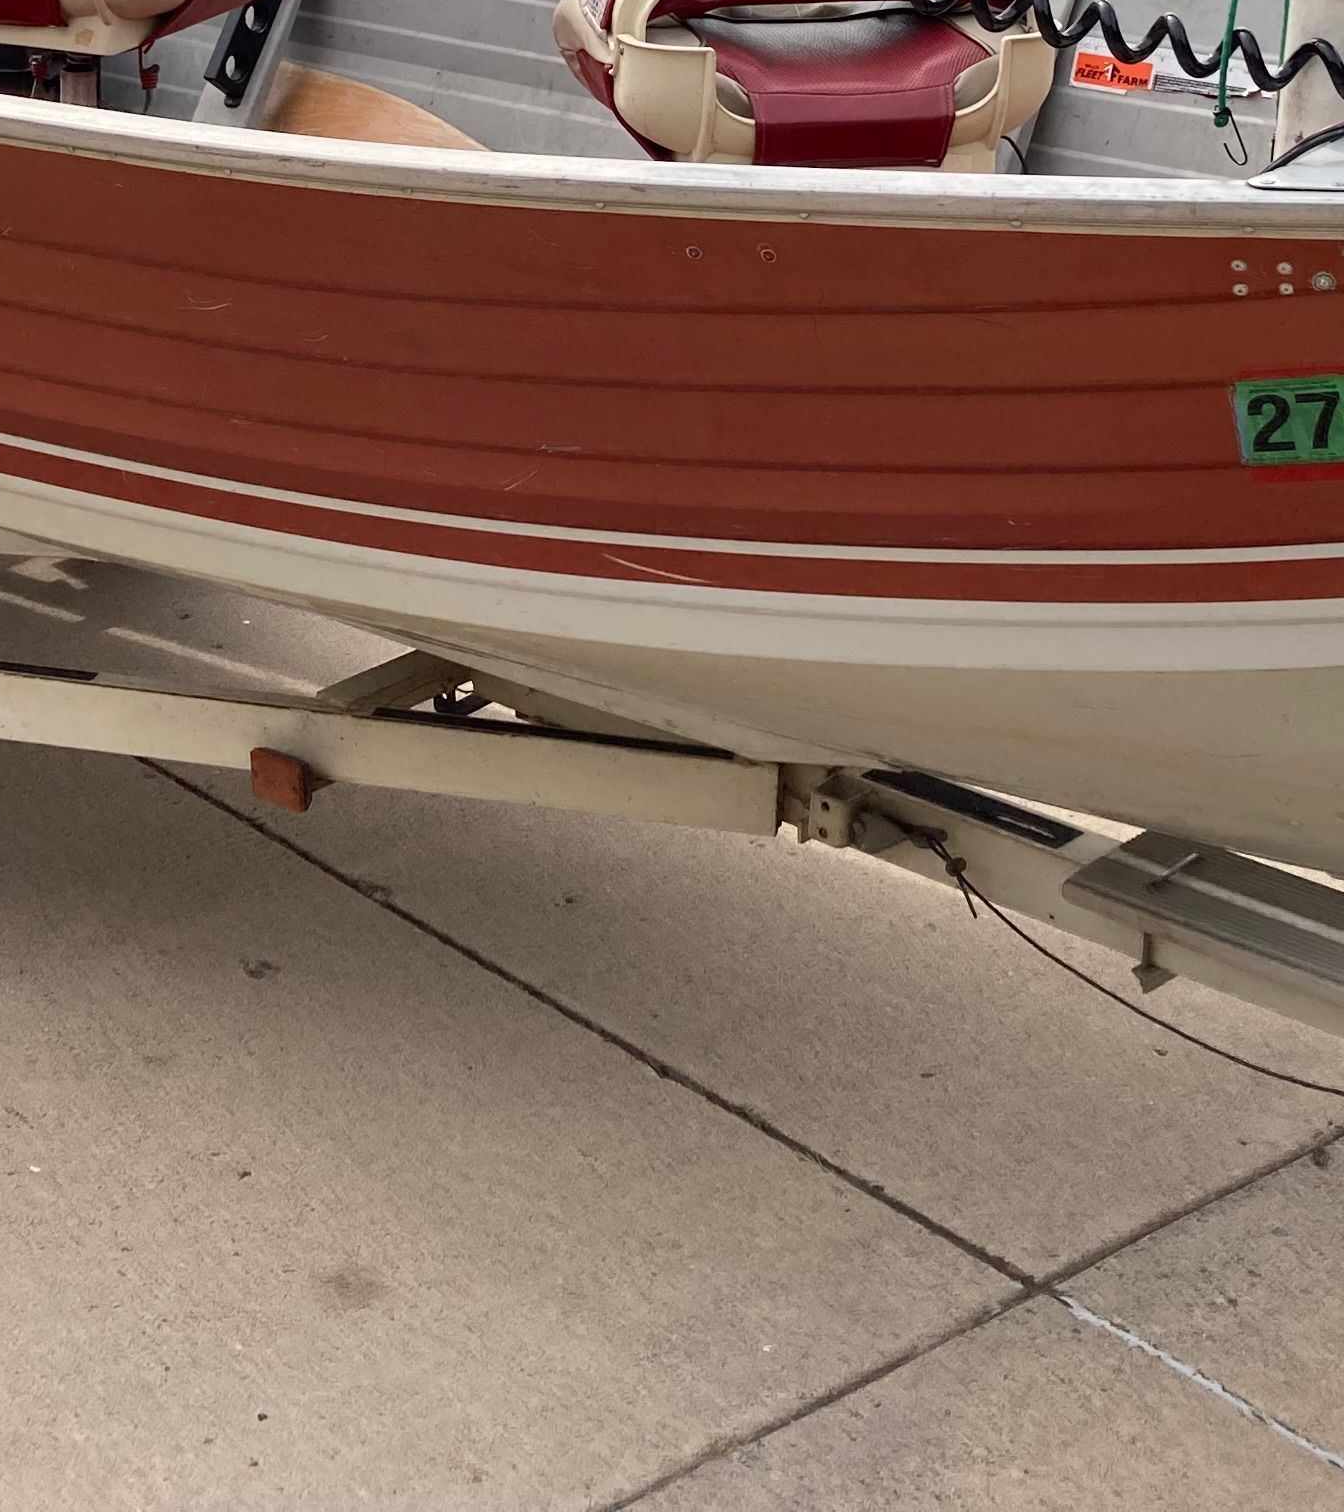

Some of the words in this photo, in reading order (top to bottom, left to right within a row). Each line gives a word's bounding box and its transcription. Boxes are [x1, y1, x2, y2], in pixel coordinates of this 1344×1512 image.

[1074, 67, 1106, 81] FLEET
[1117, 74, 1149, 87] FARM
[1247, 391, 1340, 452] 27
